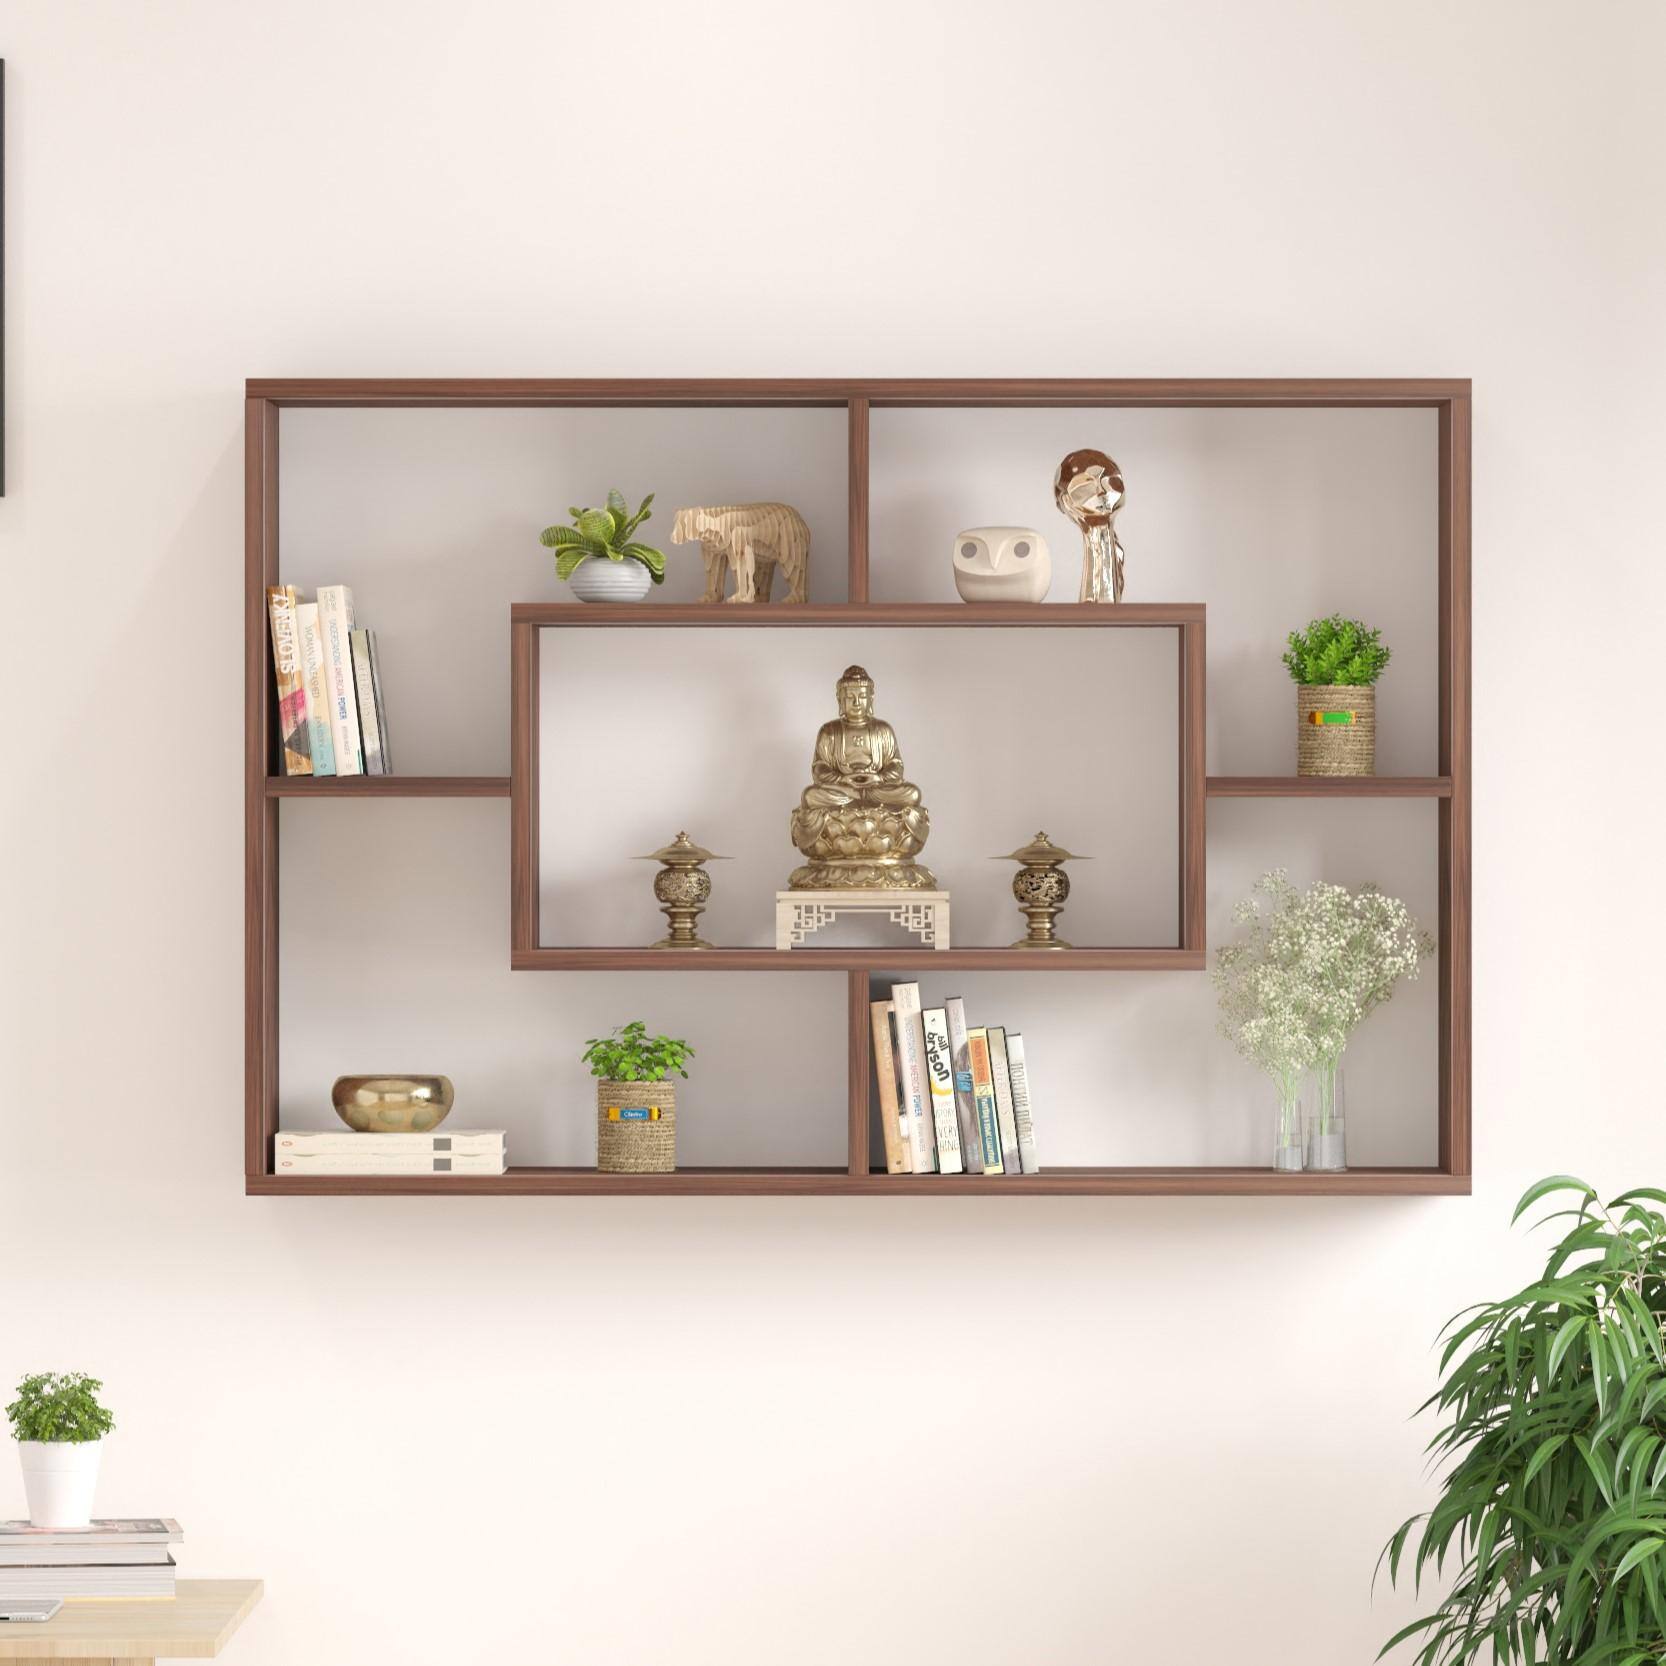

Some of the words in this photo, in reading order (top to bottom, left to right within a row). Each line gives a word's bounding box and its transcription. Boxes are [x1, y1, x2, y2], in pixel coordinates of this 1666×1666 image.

[304, 624, 316, 653] WOMAN
[338, 696, 348, 720] POWER
[937, 1034, 950, 1052] bill
[927, 1031, 951, 1082] bryson
[913, 1094, 923, 1117] POWER
